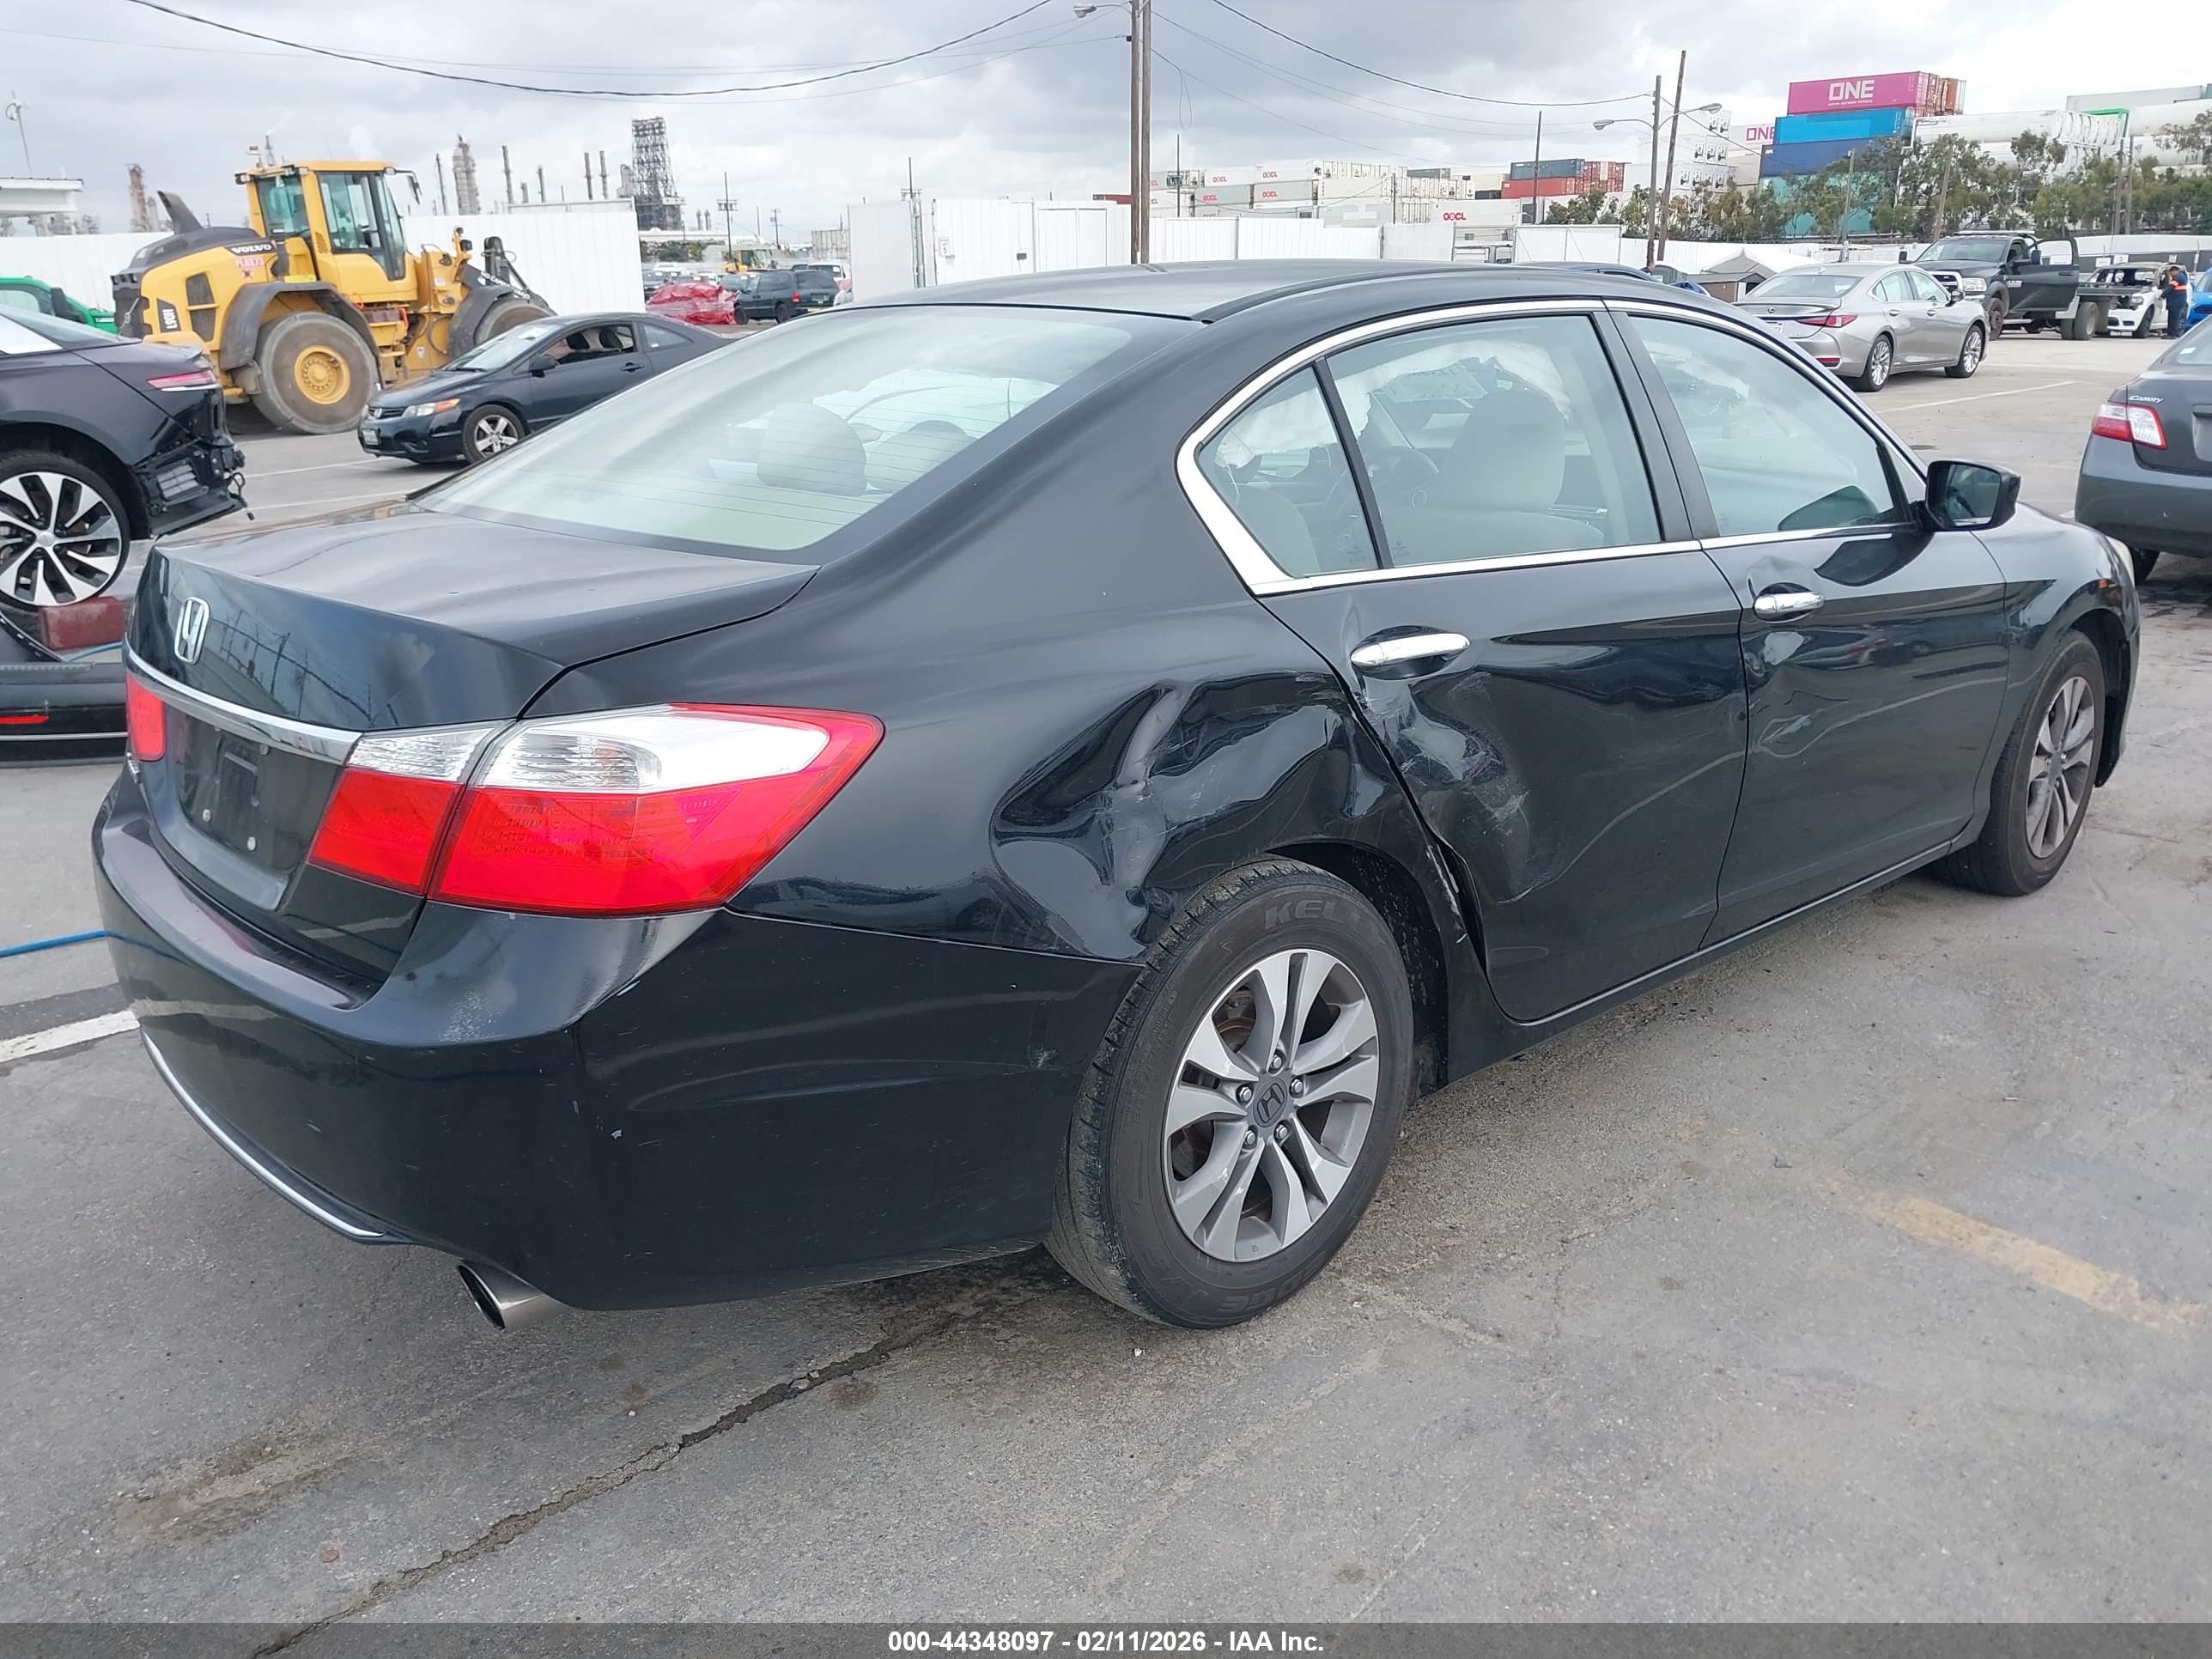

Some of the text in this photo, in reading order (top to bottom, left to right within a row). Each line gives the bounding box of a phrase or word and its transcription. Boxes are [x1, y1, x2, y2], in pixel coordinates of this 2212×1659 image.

[1828, 80, 1875, 100] ONE
[1443, 211, 1467, 222] OOCL
[231, 244, 272, 253] VOLVO
